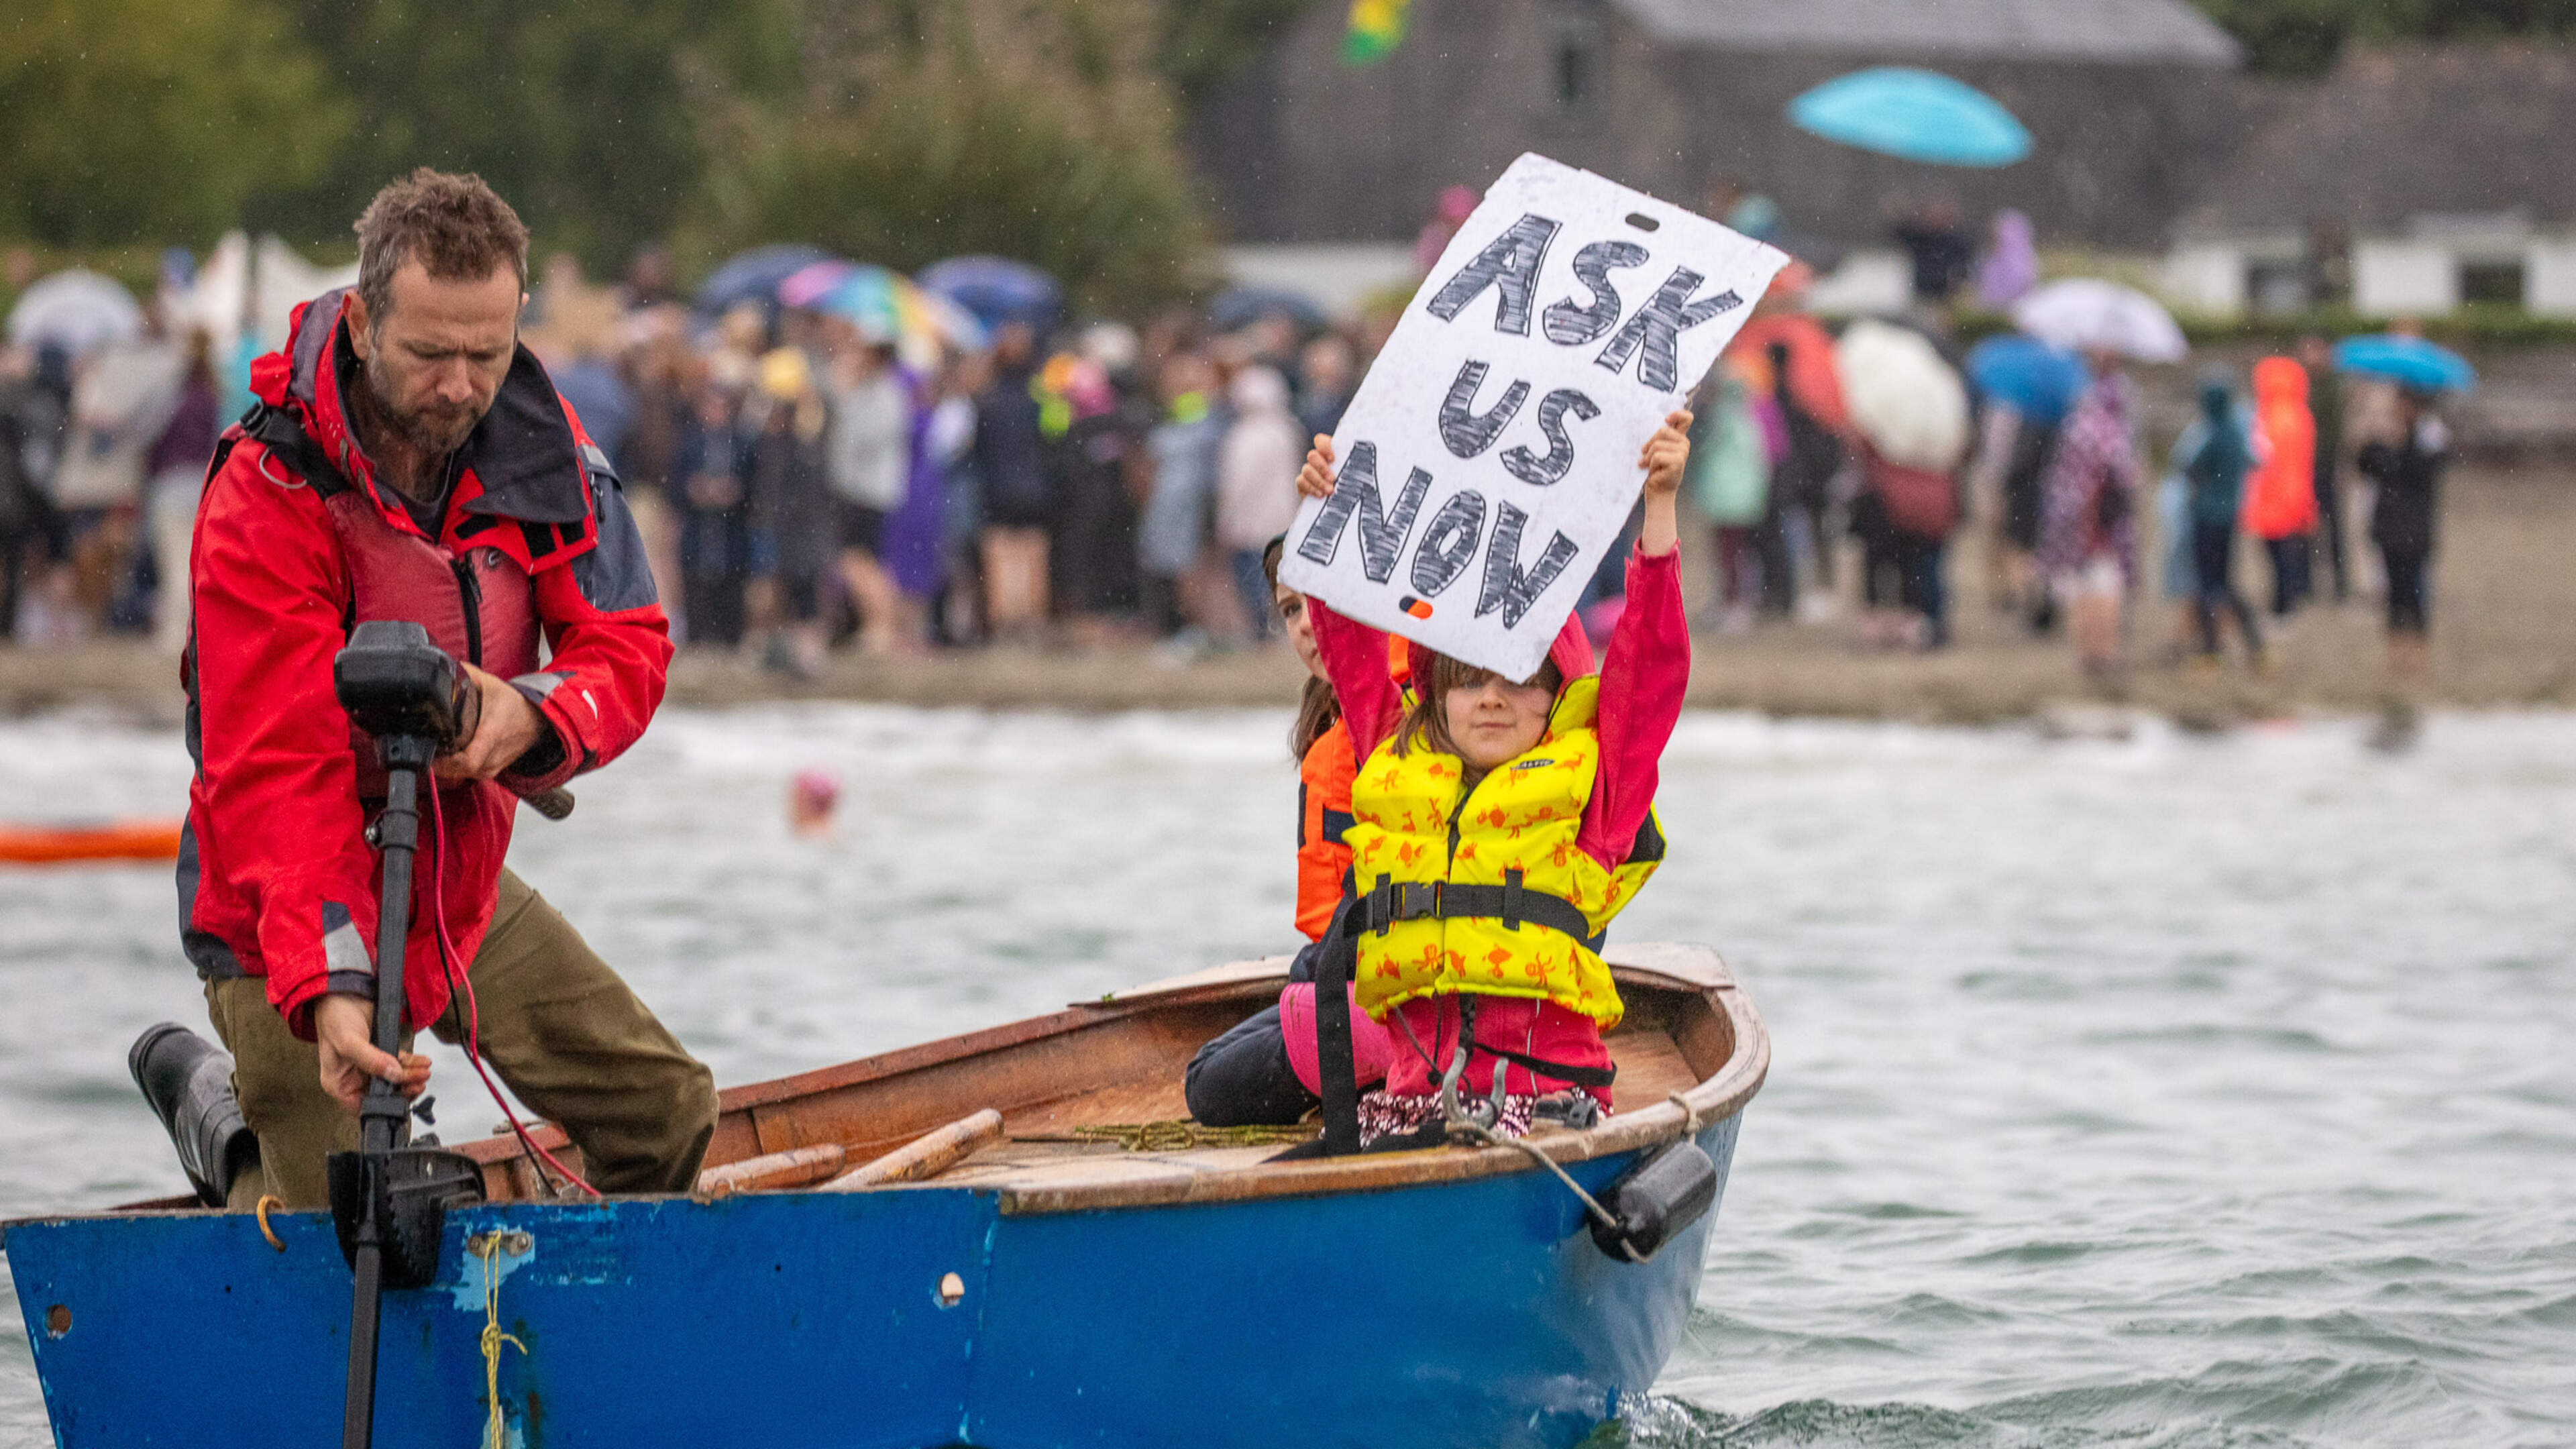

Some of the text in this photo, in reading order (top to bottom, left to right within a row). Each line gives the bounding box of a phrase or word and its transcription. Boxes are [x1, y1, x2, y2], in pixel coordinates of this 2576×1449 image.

[1426, 213, 1744, 394] ASK
[1439, 359, 1602, 486] US
[1298, 441, 1579, 629] NOW
